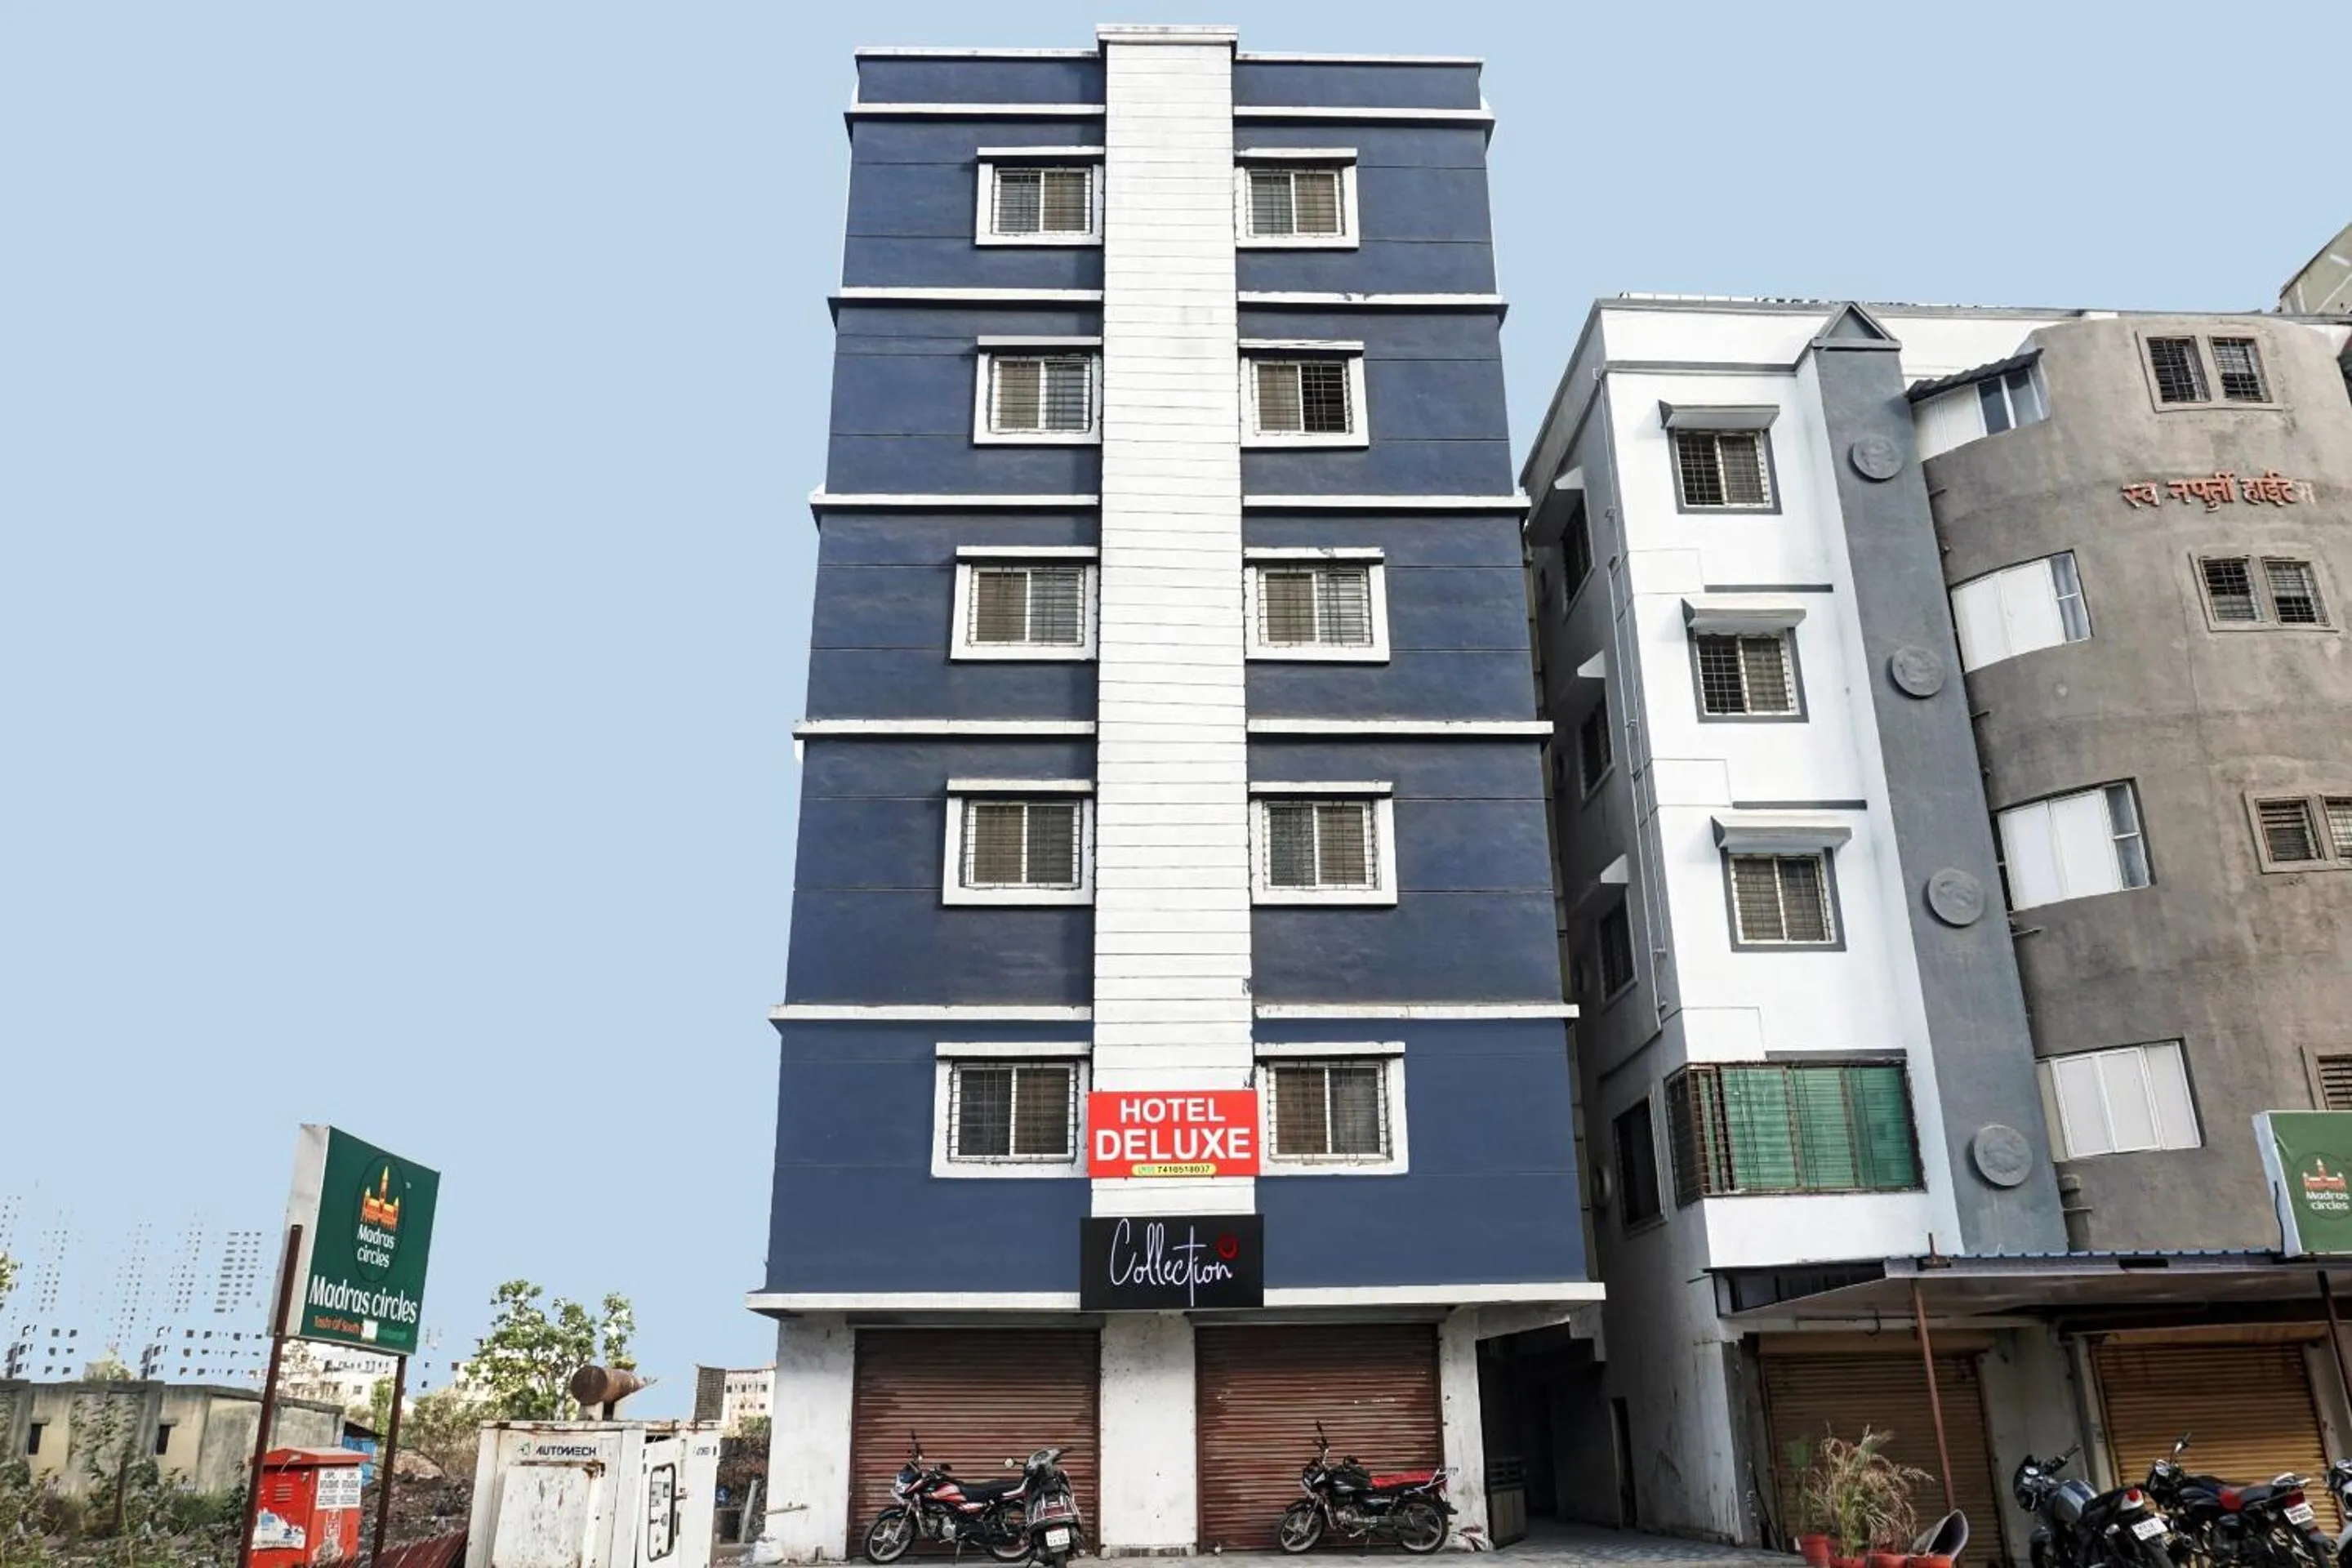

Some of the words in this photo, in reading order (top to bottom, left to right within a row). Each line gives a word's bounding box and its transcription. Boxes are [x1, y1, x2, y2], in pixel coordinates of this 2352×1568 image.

[1120, 1098, 1226, 1124] HOTEL
[1095, 1127, 1251, 1161] DELUXE
[2306, 1191, 2350, 1200] Madras
[2310, 1200, 2350, 1210] circles
[357, 1223, 395, 1250] Madras
[357, 1246, 390, 1267] circles
[1109, 1218, 1233, 1307] Collection
[309, 1274, 370, 1316] Madras
[372, 1287, 418, 1325] circles
[536, 1445, 597, 1456] AUTOMECH
